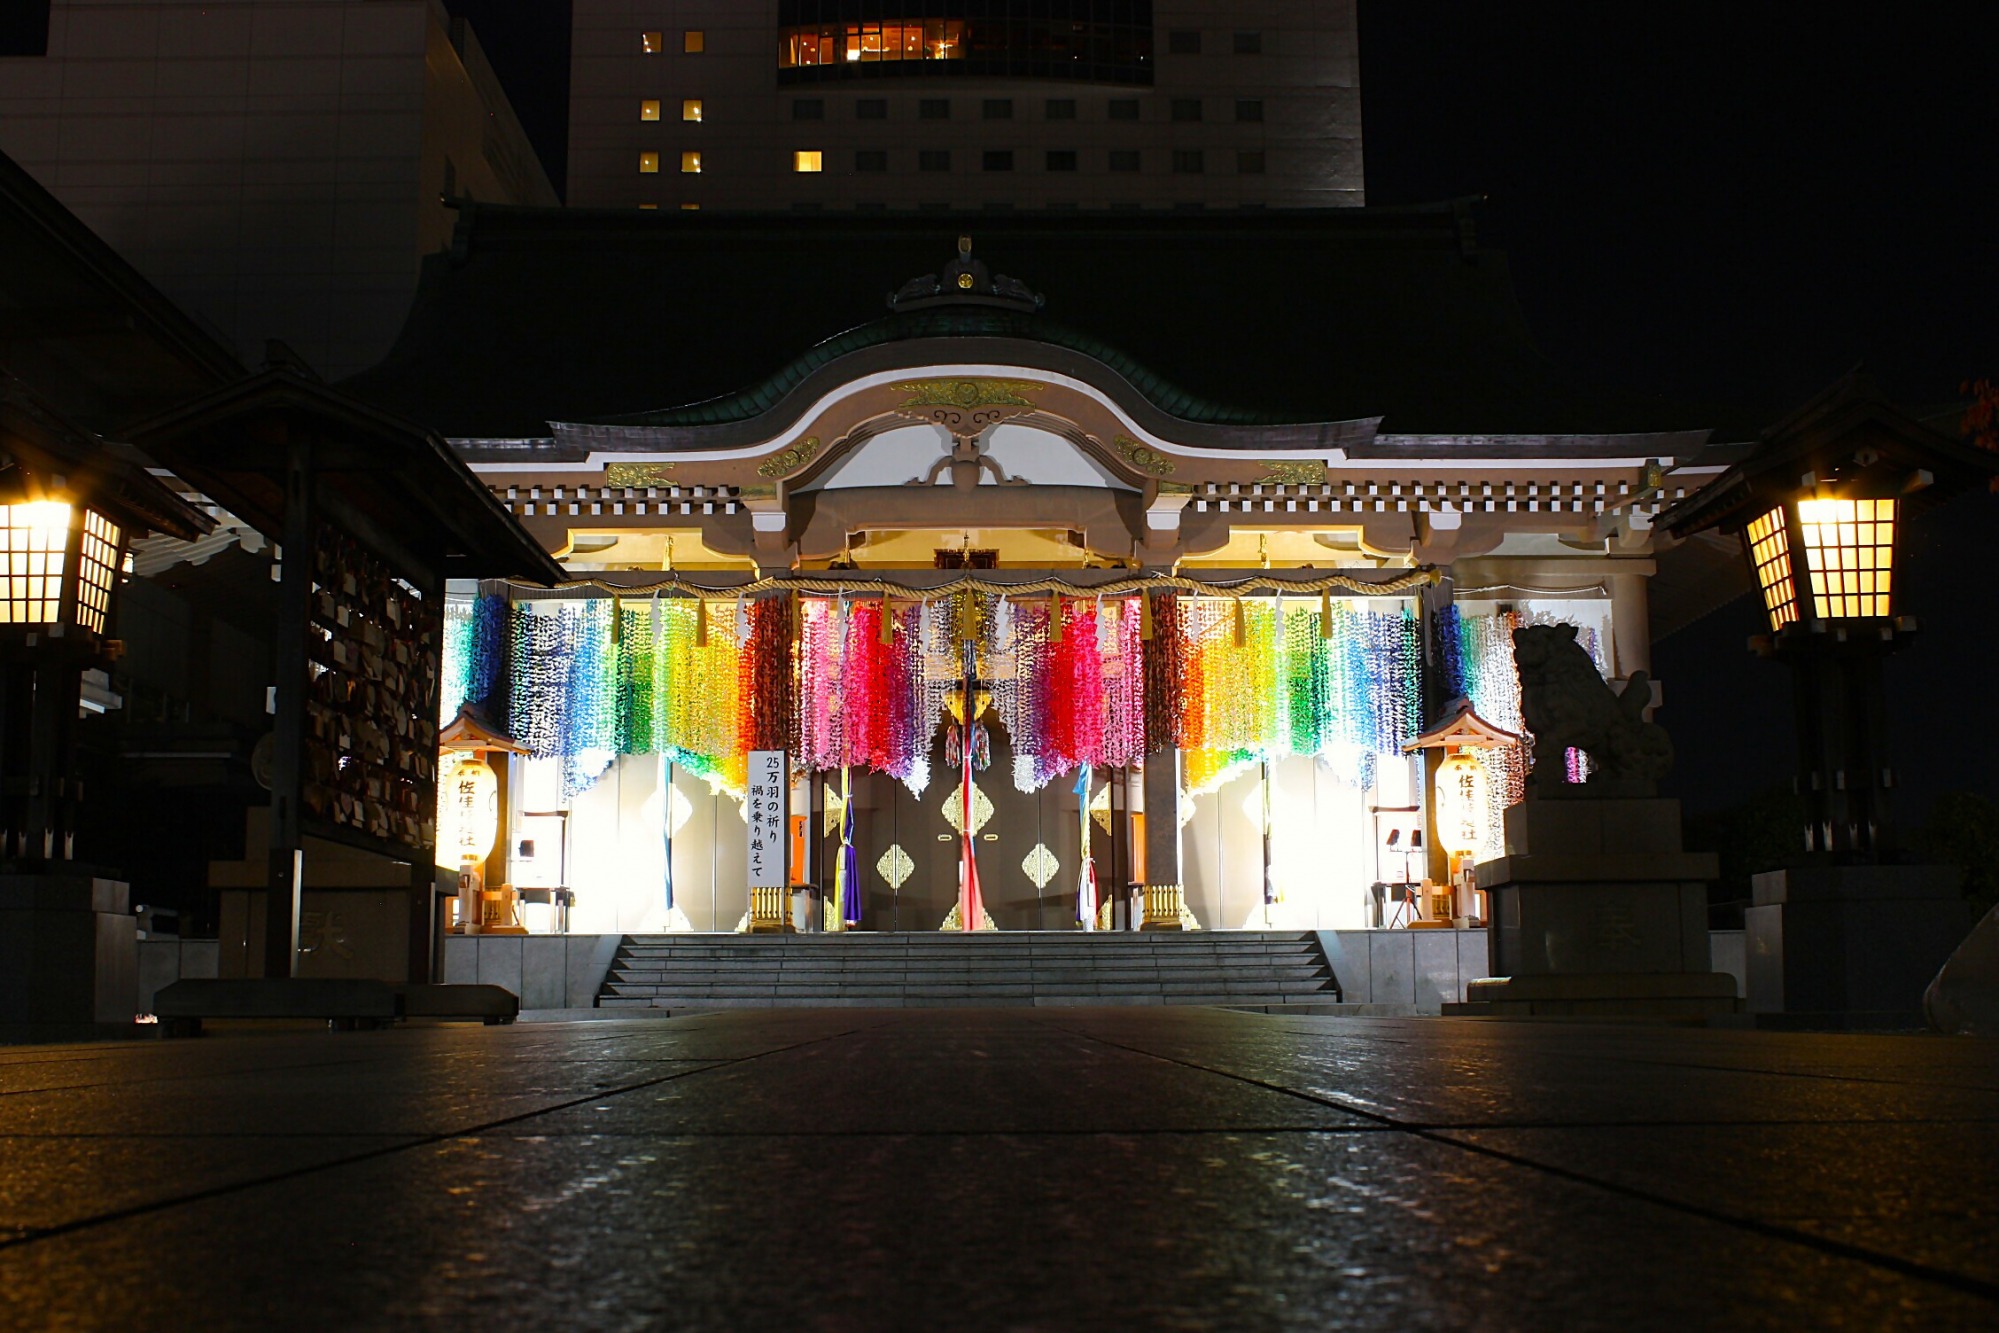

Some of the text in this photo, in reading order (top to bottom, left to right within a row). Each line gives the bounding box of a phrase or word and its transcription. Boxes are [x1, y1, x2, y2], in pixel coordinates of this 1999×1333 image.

[751, 785, 763, 877] 禍を乗り越えて
[766, 757, 779, 843] 25万羽の祈り
